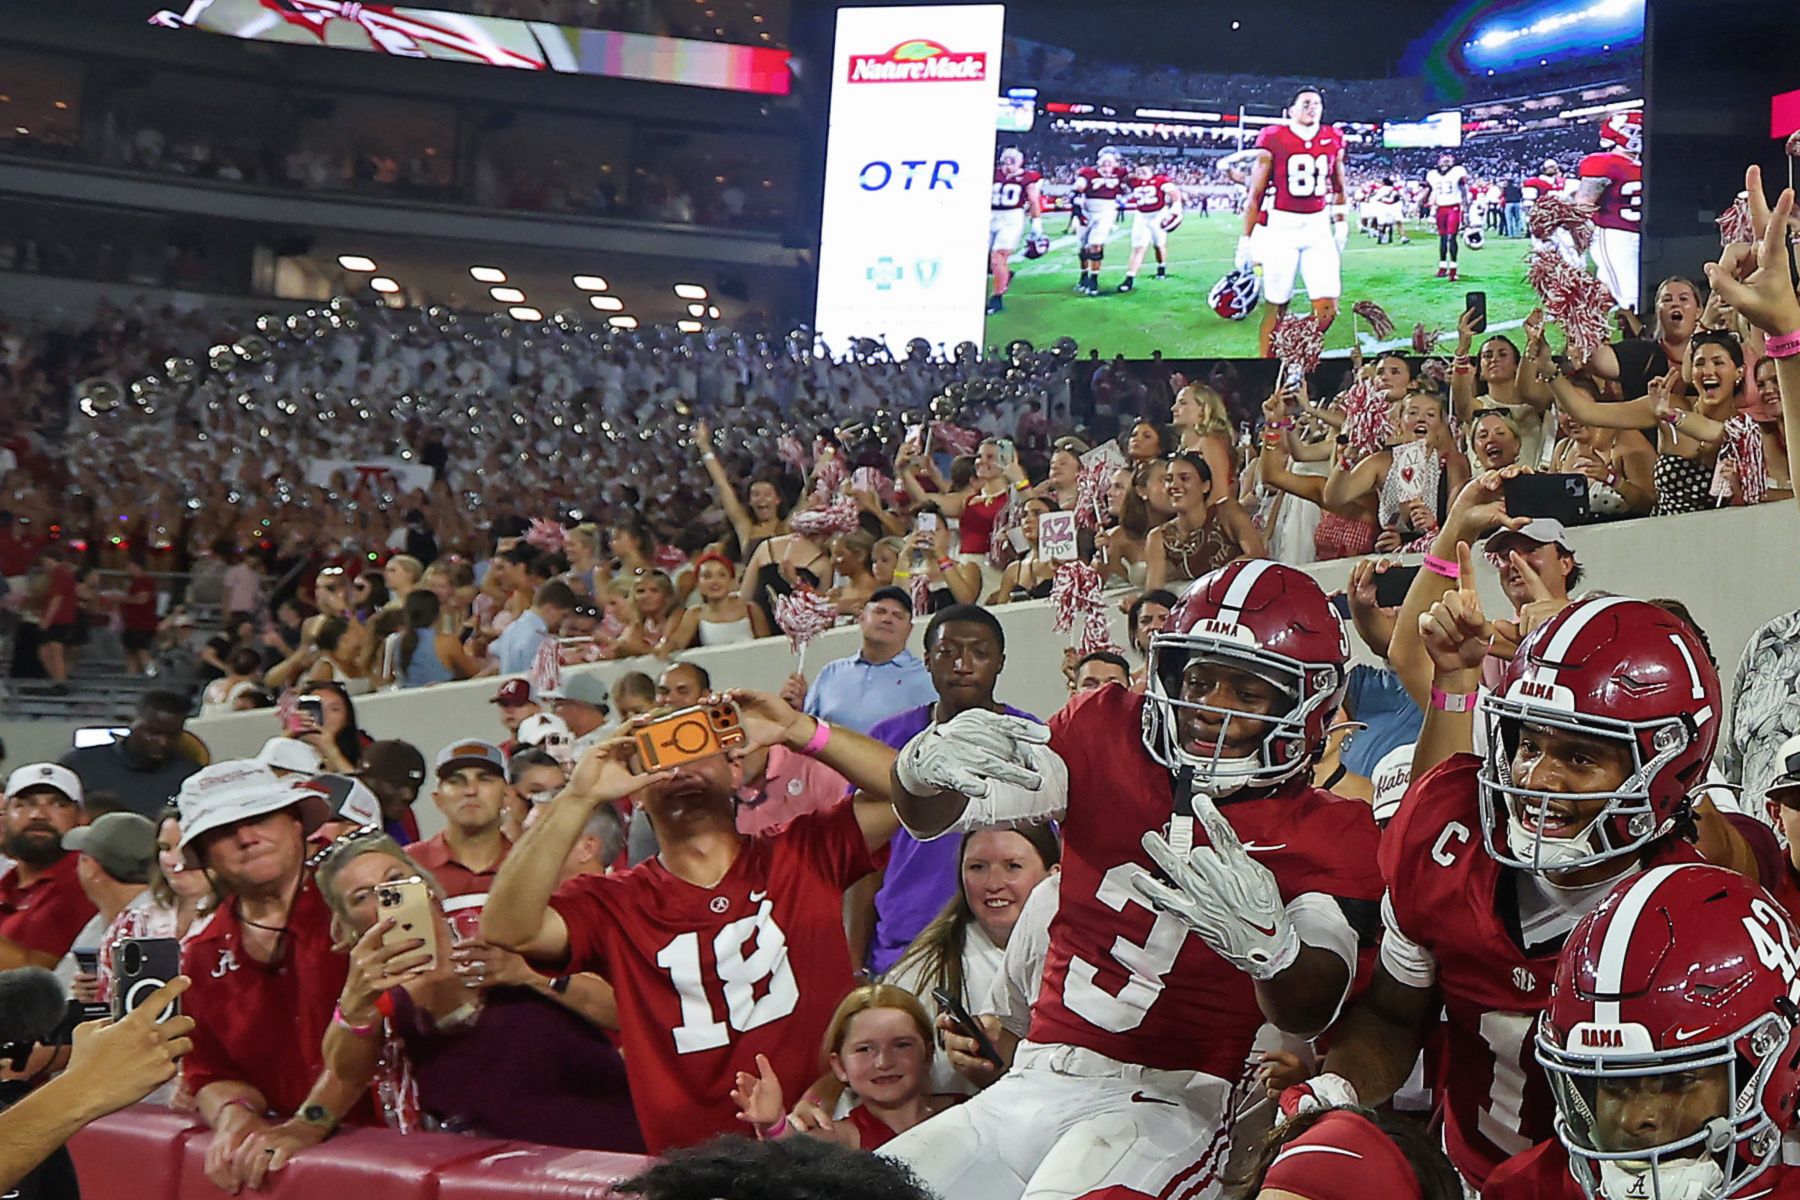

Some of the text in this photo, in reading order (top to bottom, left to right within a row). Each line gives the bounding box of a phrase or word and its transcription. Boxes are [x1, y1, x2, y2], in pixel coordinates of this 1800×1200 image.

[859, 160, 960, 191] OTR
[1287, 154, 1329, 197] 81
[1205, 619, 1239, 638] BAMA
[1668, 634, 1705, 700] 1
[1519, 680, 1555, 701] BAMA
[1432, 821, 1470, 867] C
[1063, 861, 1191, 1034] 3
[656, 900, 800, 1054] 18
[1580, 1028, 1625, 1048] BAMA
[1478, 1010, 1534, 1156] 1
